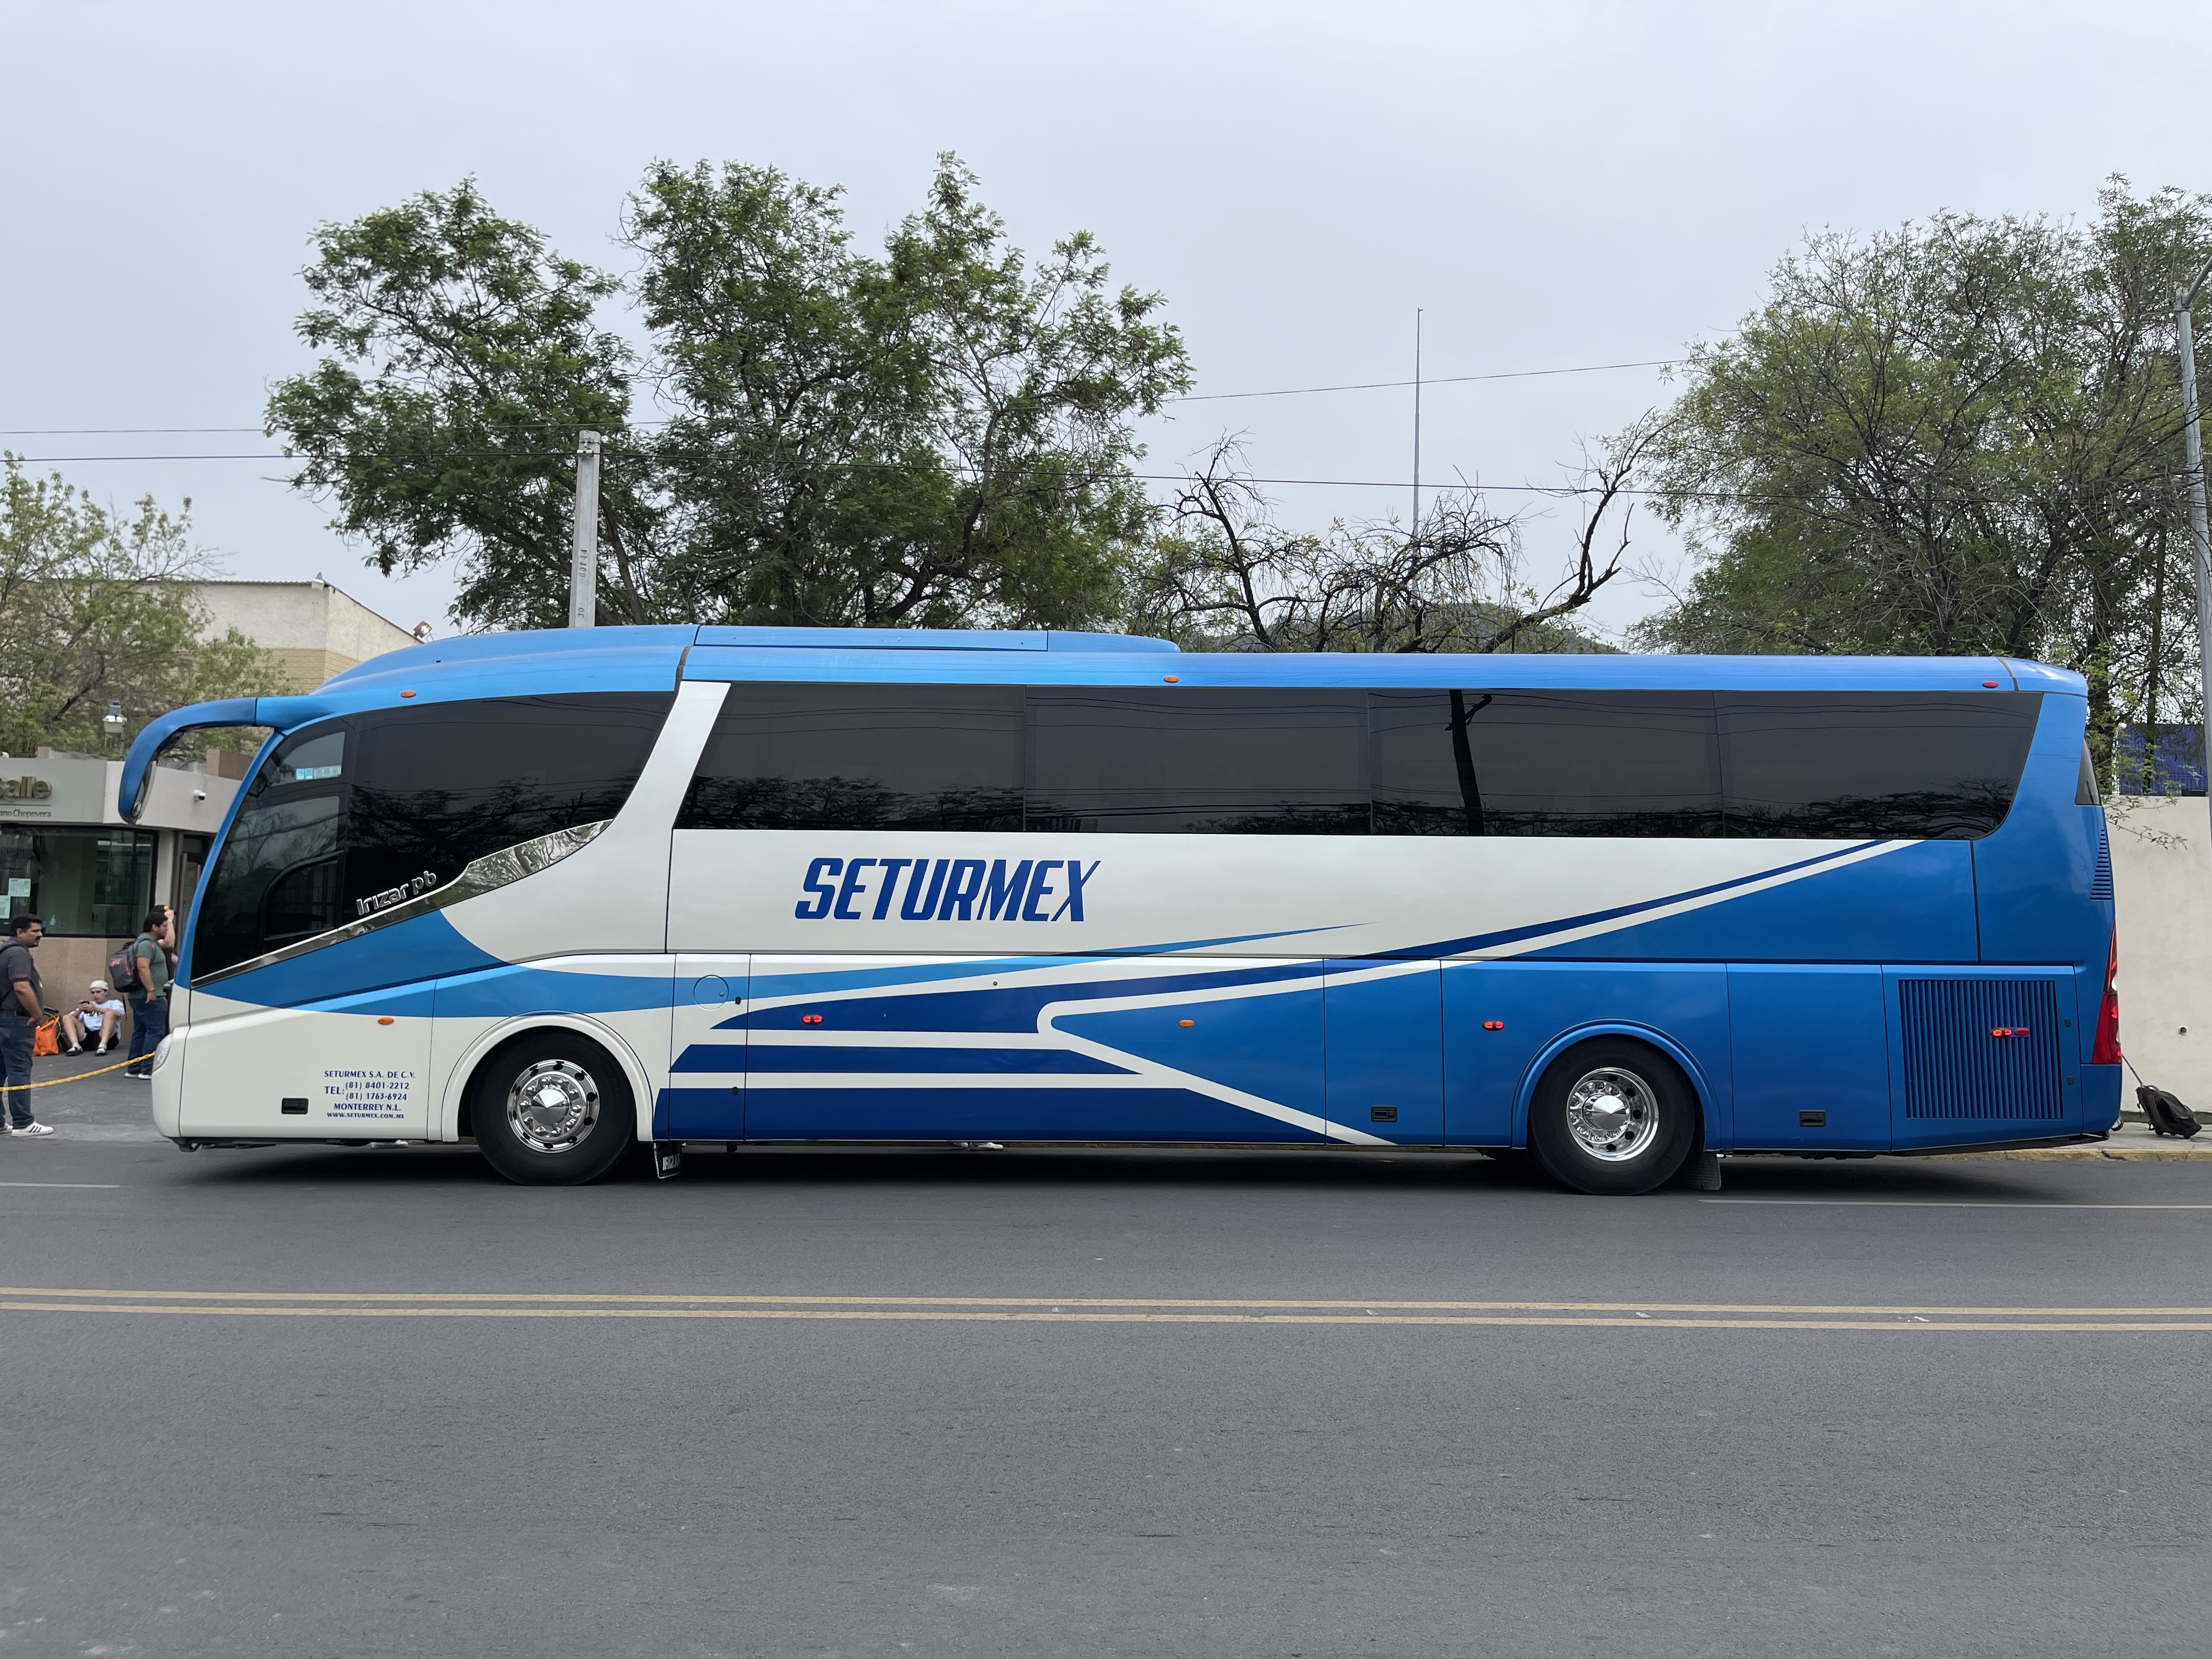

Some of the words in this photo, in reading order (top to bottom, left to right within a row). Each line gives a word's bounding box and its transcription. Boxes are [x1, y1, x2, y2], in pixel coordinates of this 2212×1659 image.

[13, 809, 52, 819] Chepevera
[357, 883, 409, 916] Irizar
[411, 871, 437, 895] pb
[794, 857, 1102, 922] SETURMEX
[324, 1086, 345, 1095] TEL:
[346, 1082, 362, 1091] (81)
[346, 1092, 363, 1101] (81)
